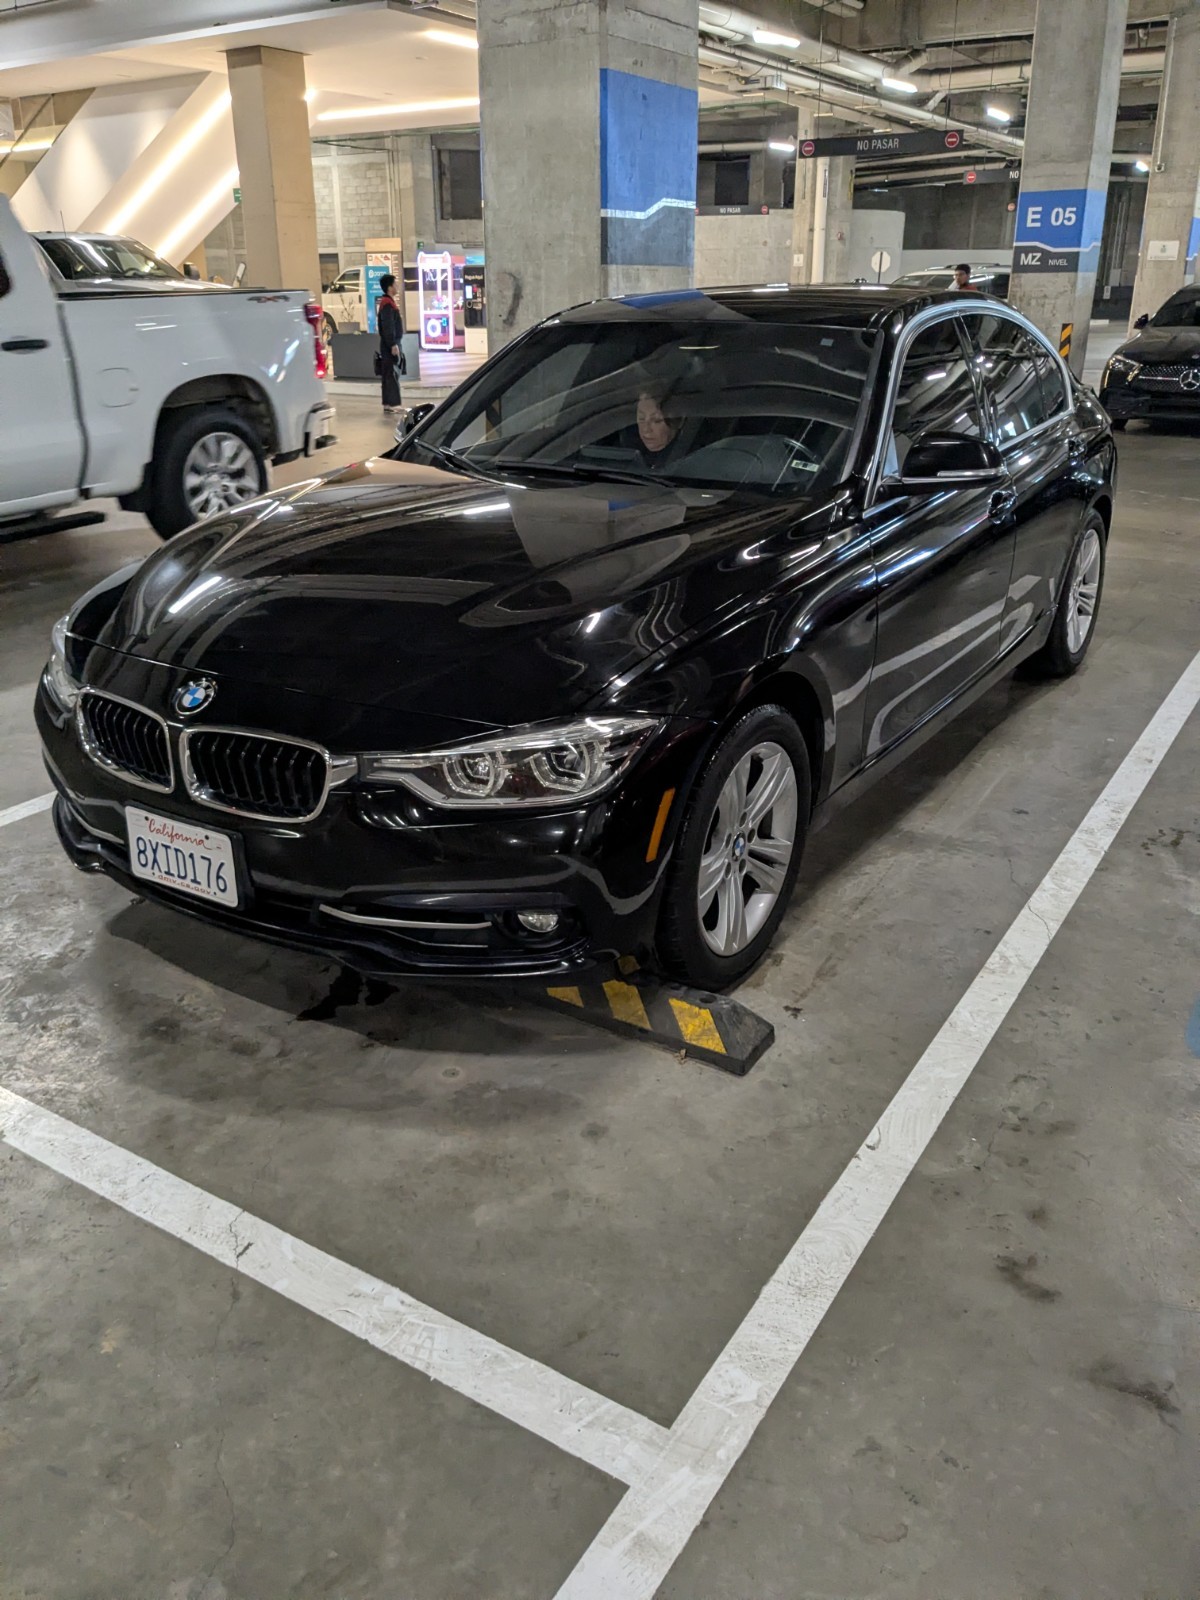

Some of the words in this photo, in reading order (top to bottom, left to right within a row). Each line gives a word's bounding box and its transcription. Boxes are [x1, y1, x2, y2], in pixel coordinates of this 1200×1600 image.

[857, 140, 869, 151] NO
[871, 138, 899, 150] PASAR
[1009, 170, 1019, 179] NO
[1026, 206, 1042, 228] E
[1050, 207, 1077, 226] 05
[1020, 253, 1042, 265] MZ
[148, 819, 212, 850] California
[136, 836, 227, 893] 8XID176
[158, 874, 212, 895] dmv.ca.gov
